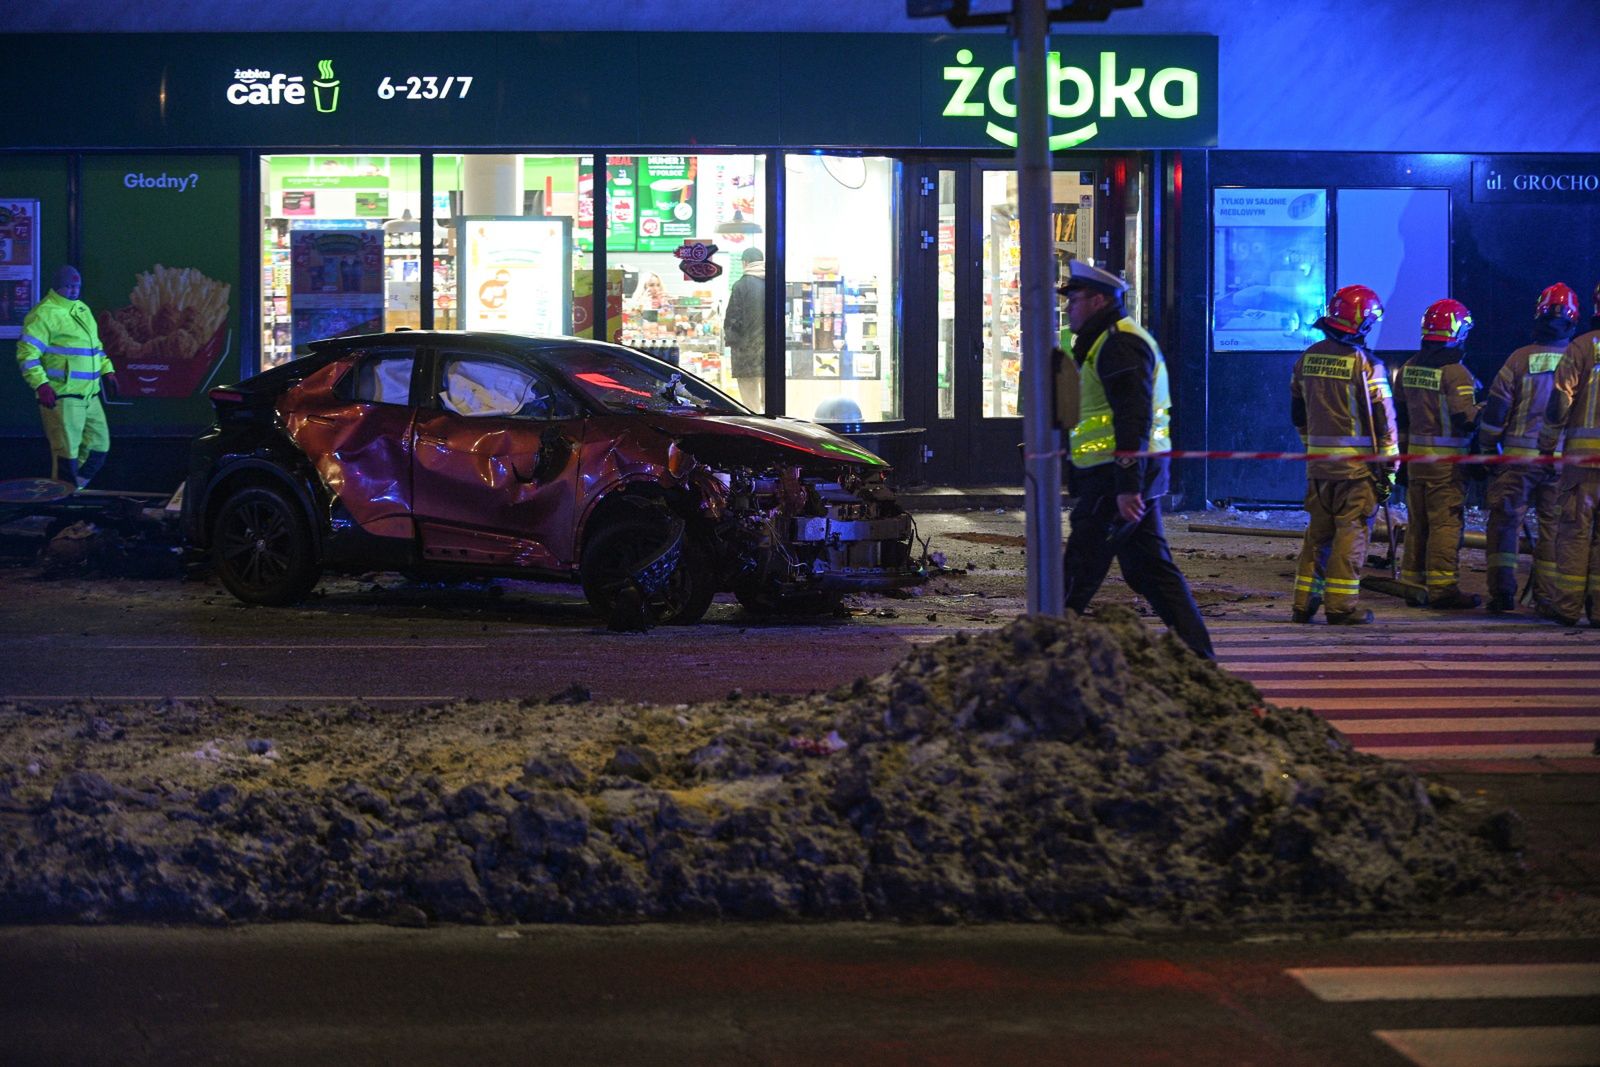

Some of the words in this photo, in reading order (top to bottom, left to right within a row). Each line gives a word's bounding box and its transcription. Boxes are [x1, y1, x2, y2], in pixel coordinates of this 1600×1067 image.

[234, 68, 271, 79] żabka
[226, 74, 305, 105] café
[377, 76, 473, 100] 6-23/7
[123, 172, 200, 193] Głodny?
[1220, 198, 1245, 206] TYLKO
[1246, 198, 1255, 206] W
[1255, 198, 1287, 206] SALONIE
[1220, 208, 1266, 217] MEBLOWYM
[1220, 338, 1239, 346] sofa
